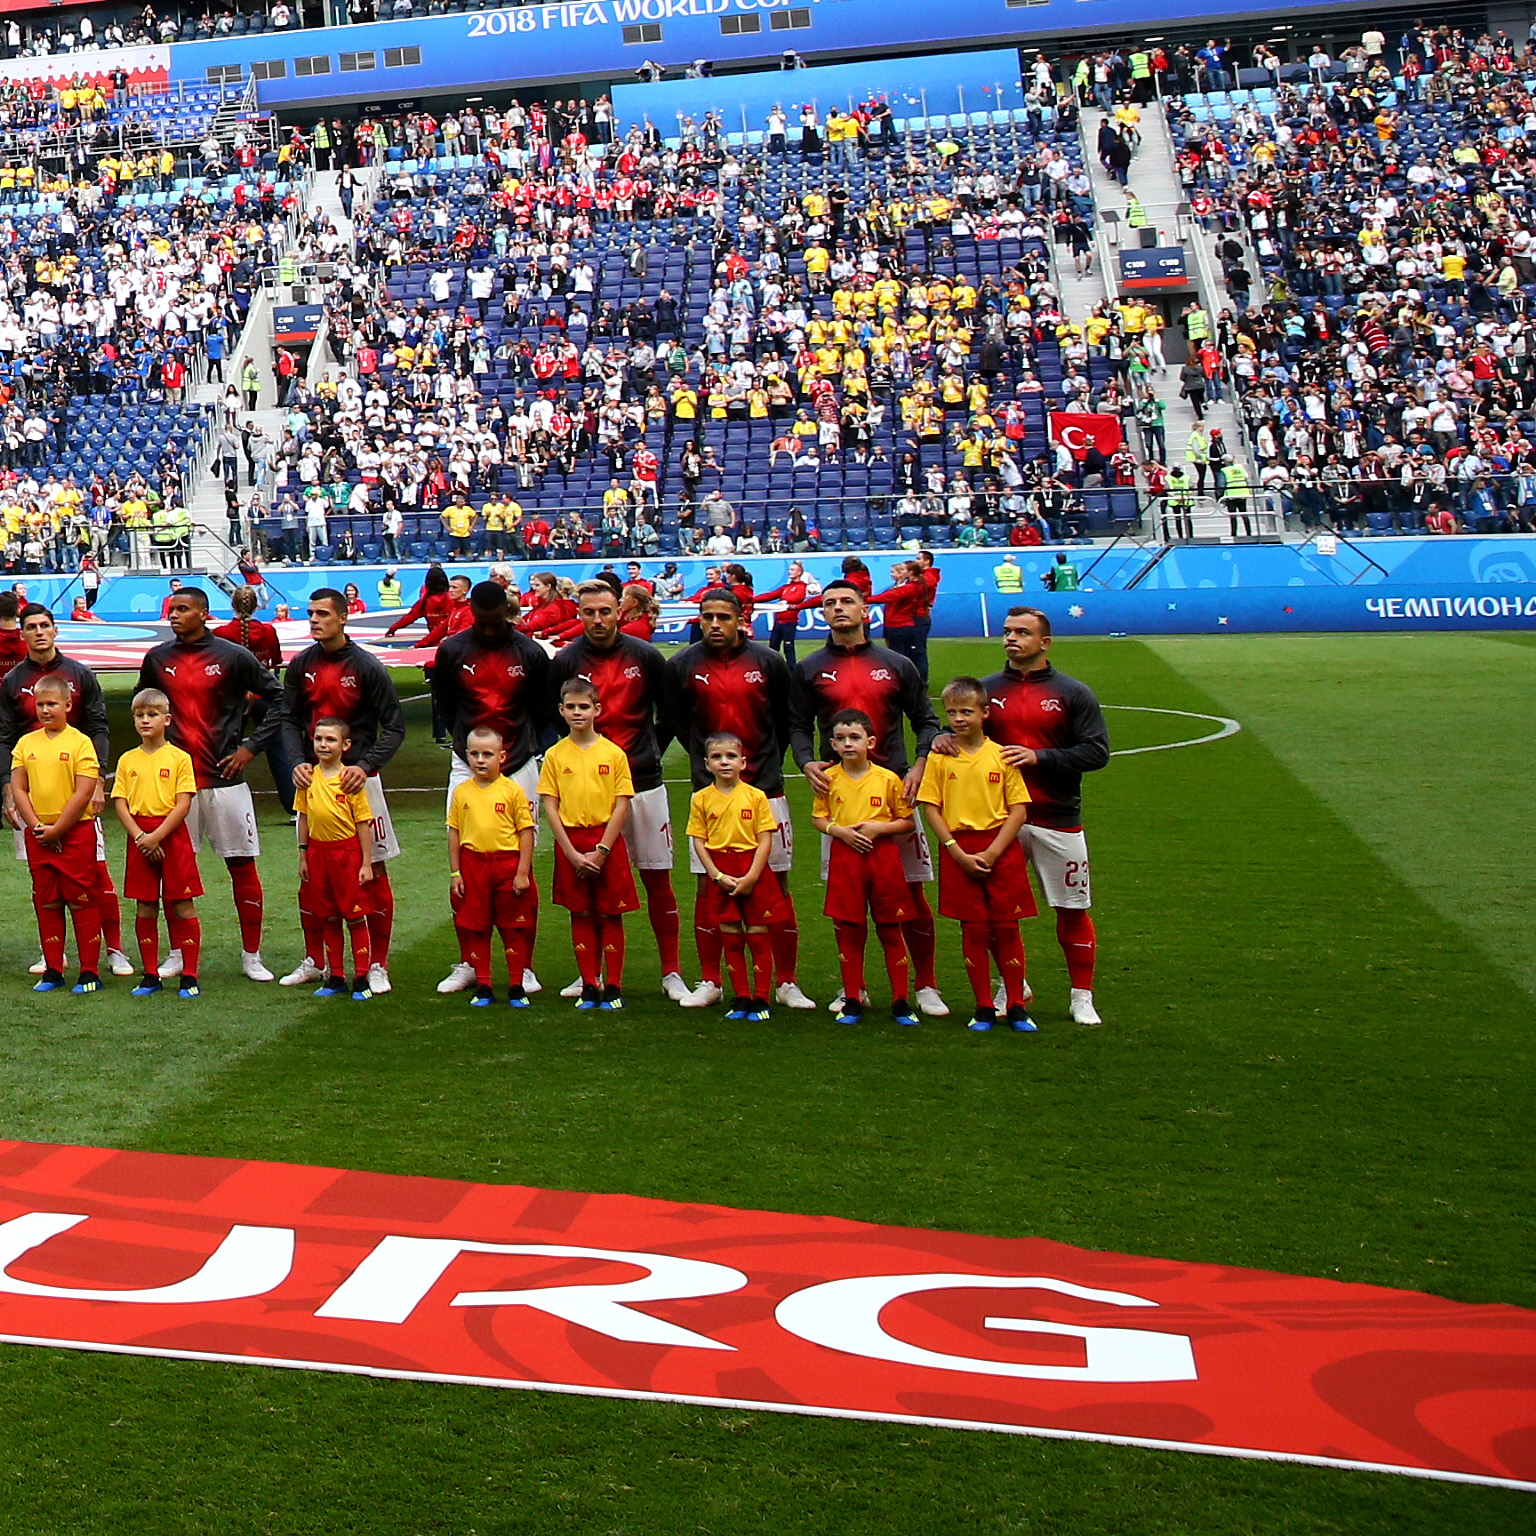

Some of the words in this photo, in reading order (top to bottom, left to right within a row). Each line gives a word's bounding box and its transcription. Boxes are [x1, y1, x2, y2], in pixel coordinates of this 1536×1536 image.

[467, 9, 536, 37] 2018
[542, 3, 609, 30] FIFA
[368, 816, 387, 843] 10
[1064, 860, 1088, 888] 23
